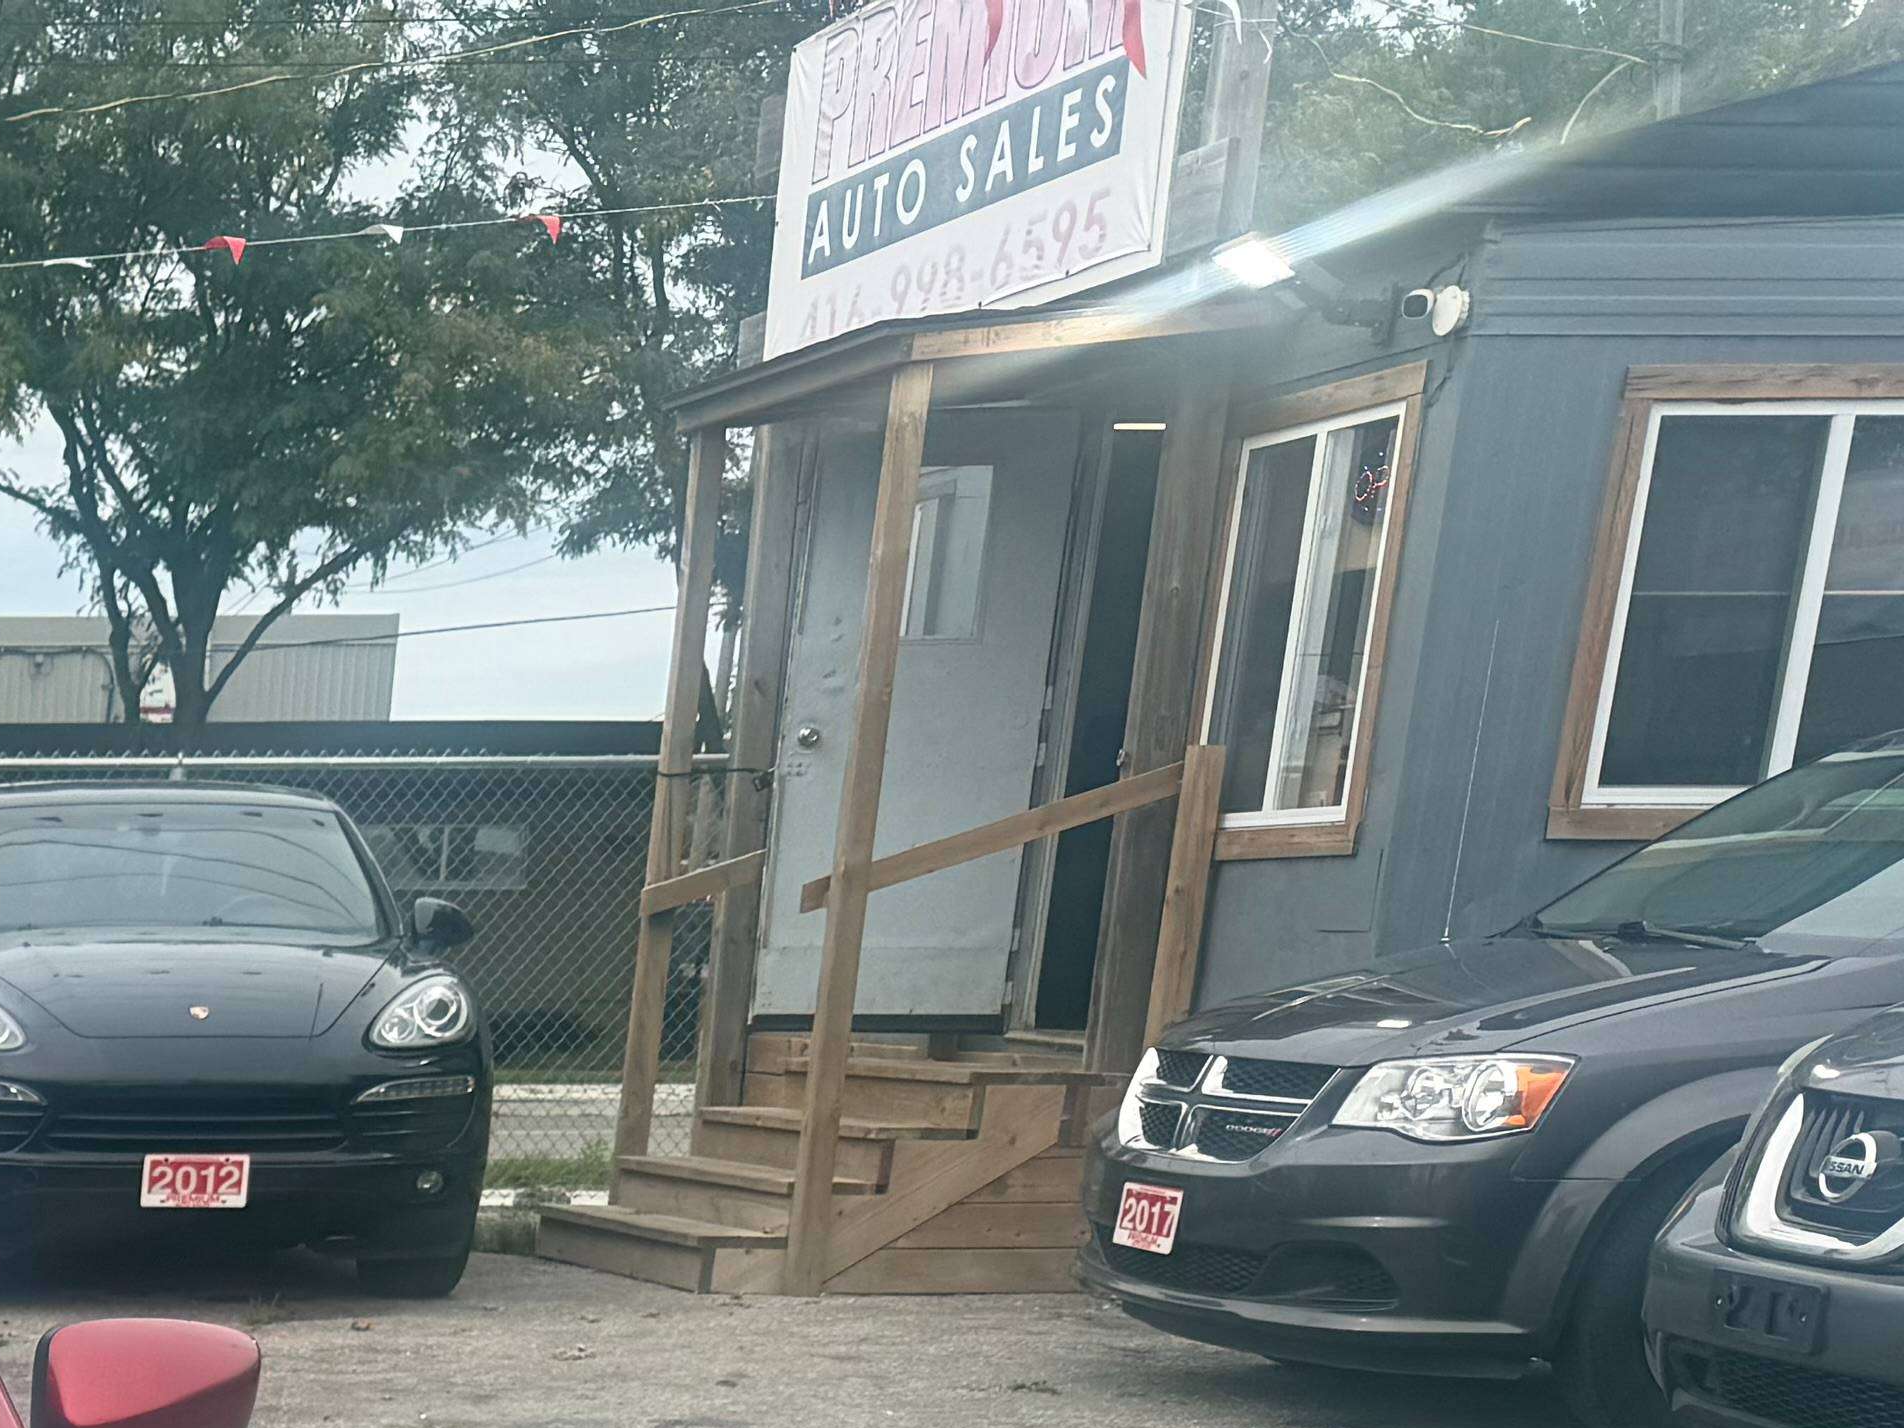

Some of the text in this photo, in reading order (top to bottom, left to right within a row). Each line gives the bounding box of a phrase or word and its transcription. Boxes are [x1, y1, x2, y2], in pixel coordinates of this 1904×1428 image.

[807, 74, 1116, 266] AUTO SALES
[150, 1165, 241, 1196] 2012
[1120, 1196, 1176, 1237] 2017
